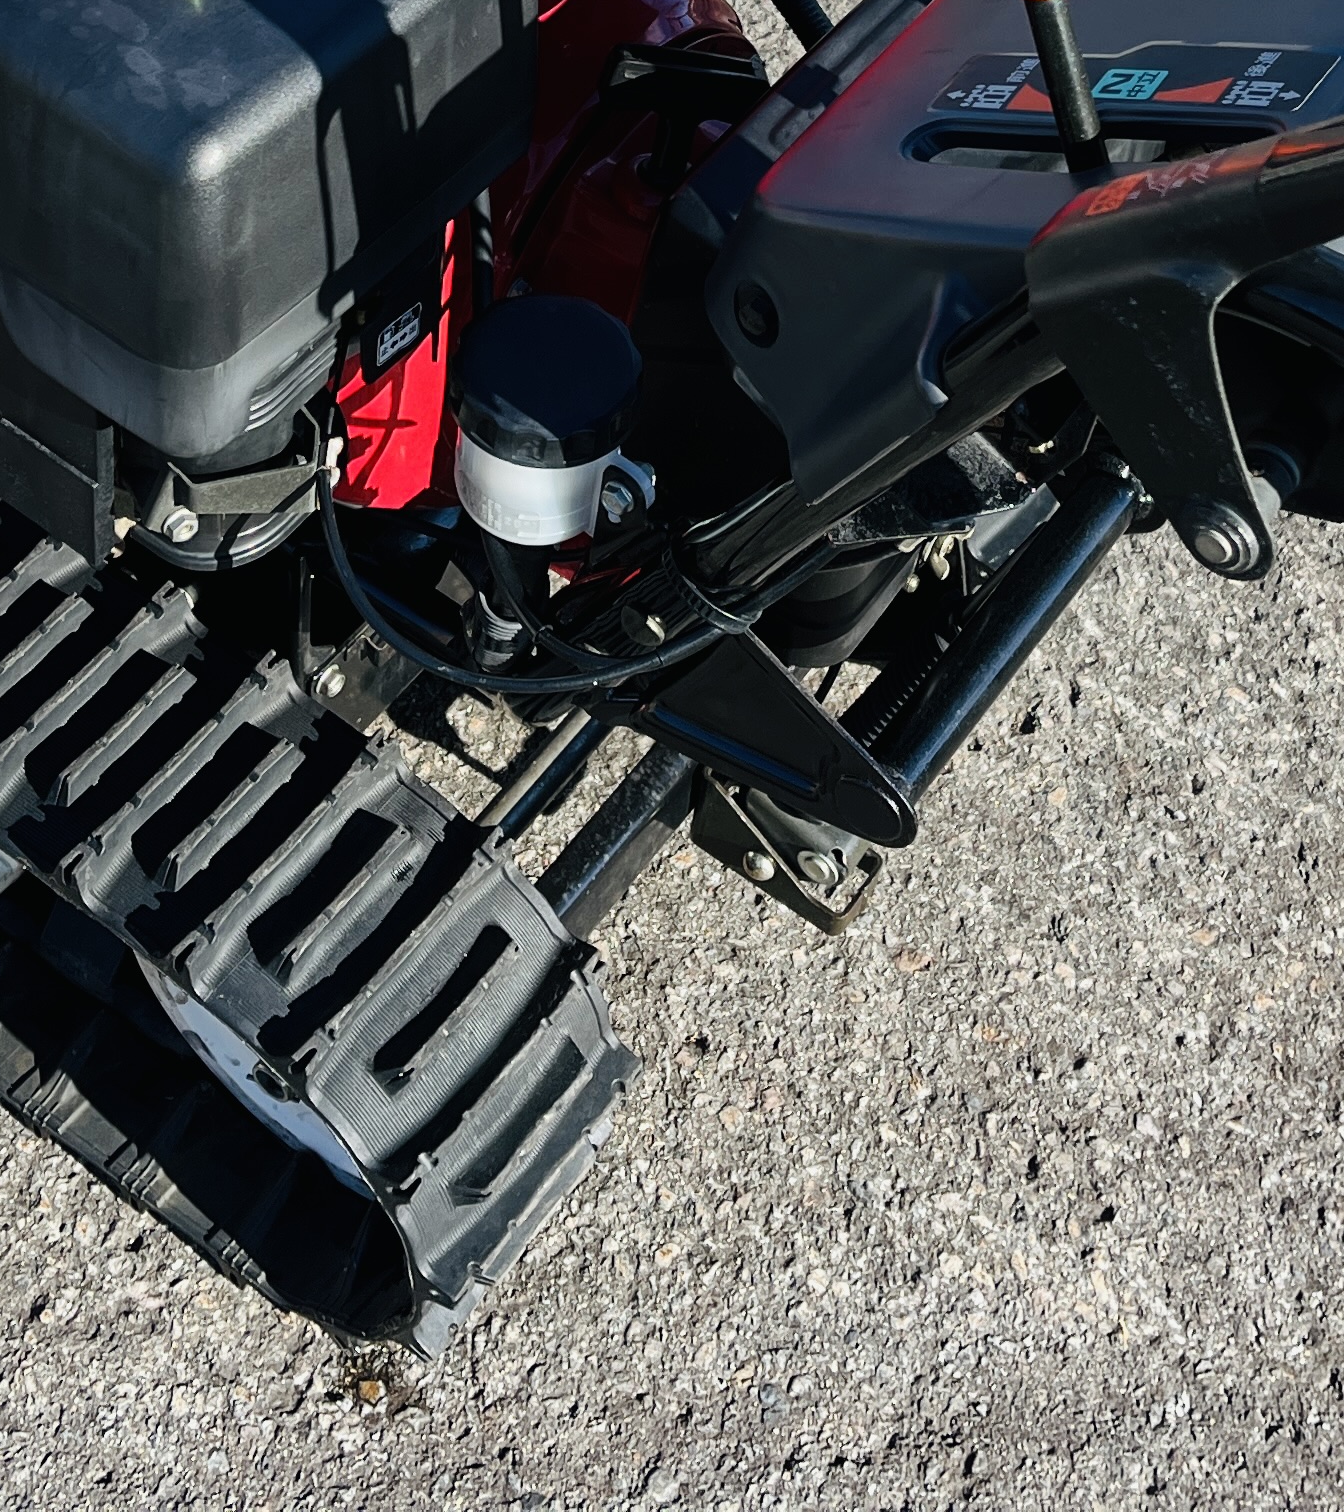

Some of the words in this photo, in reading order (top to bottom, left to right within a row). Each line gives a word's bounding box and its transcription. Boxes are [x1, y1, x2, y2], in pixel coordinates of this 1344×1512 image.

[1006, 57, 1040, 83] 前進
[1244, 51, 1283, 77] 後進
[1098, 72, 1135, 95] N
[1126, 71, 1160, 97] 中立
